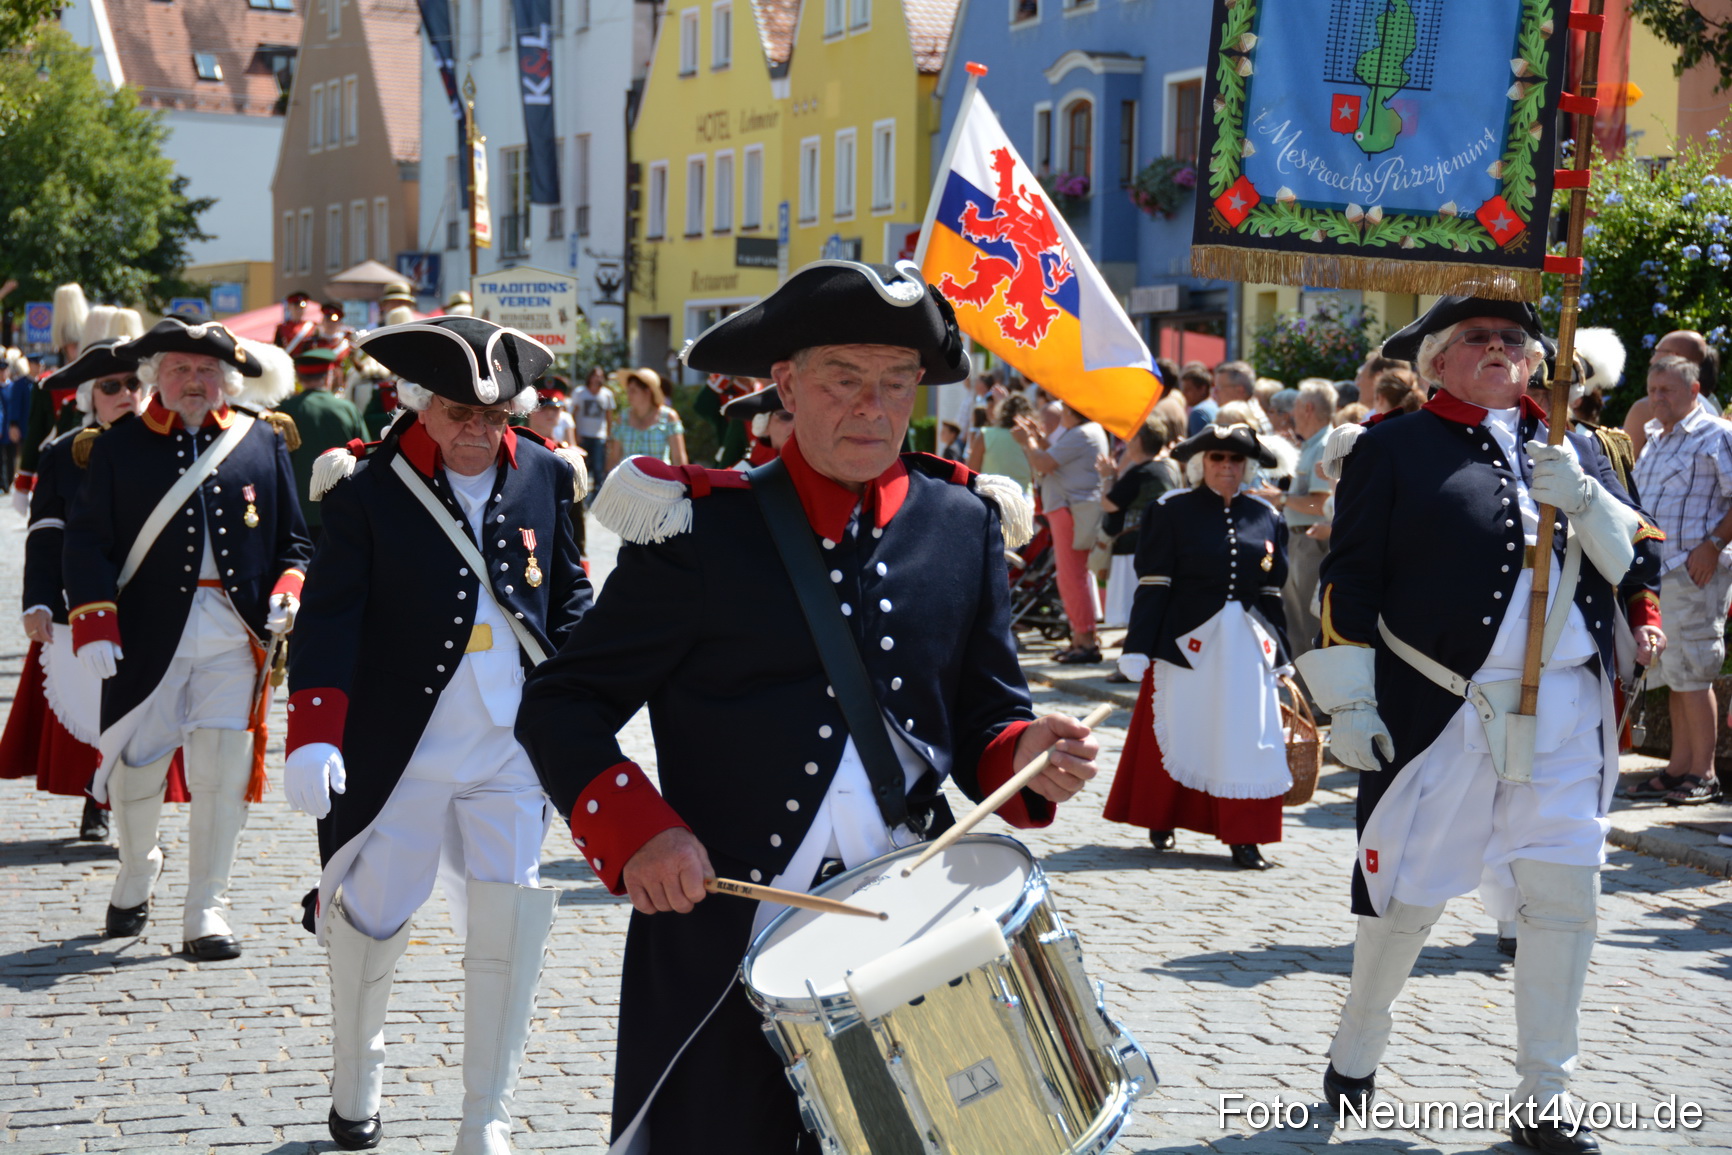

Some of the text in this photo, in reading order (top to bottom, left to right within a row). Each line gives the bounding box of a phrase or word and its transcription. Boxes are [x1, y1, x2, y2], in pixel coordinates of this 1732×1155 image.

[520, 23, 551, 105] K&L
[696, 110, 731, 144] HOTEL
[480, 282, 573, 294] TRADITIONS-
[498, 296, 551, 307] VEREIN
